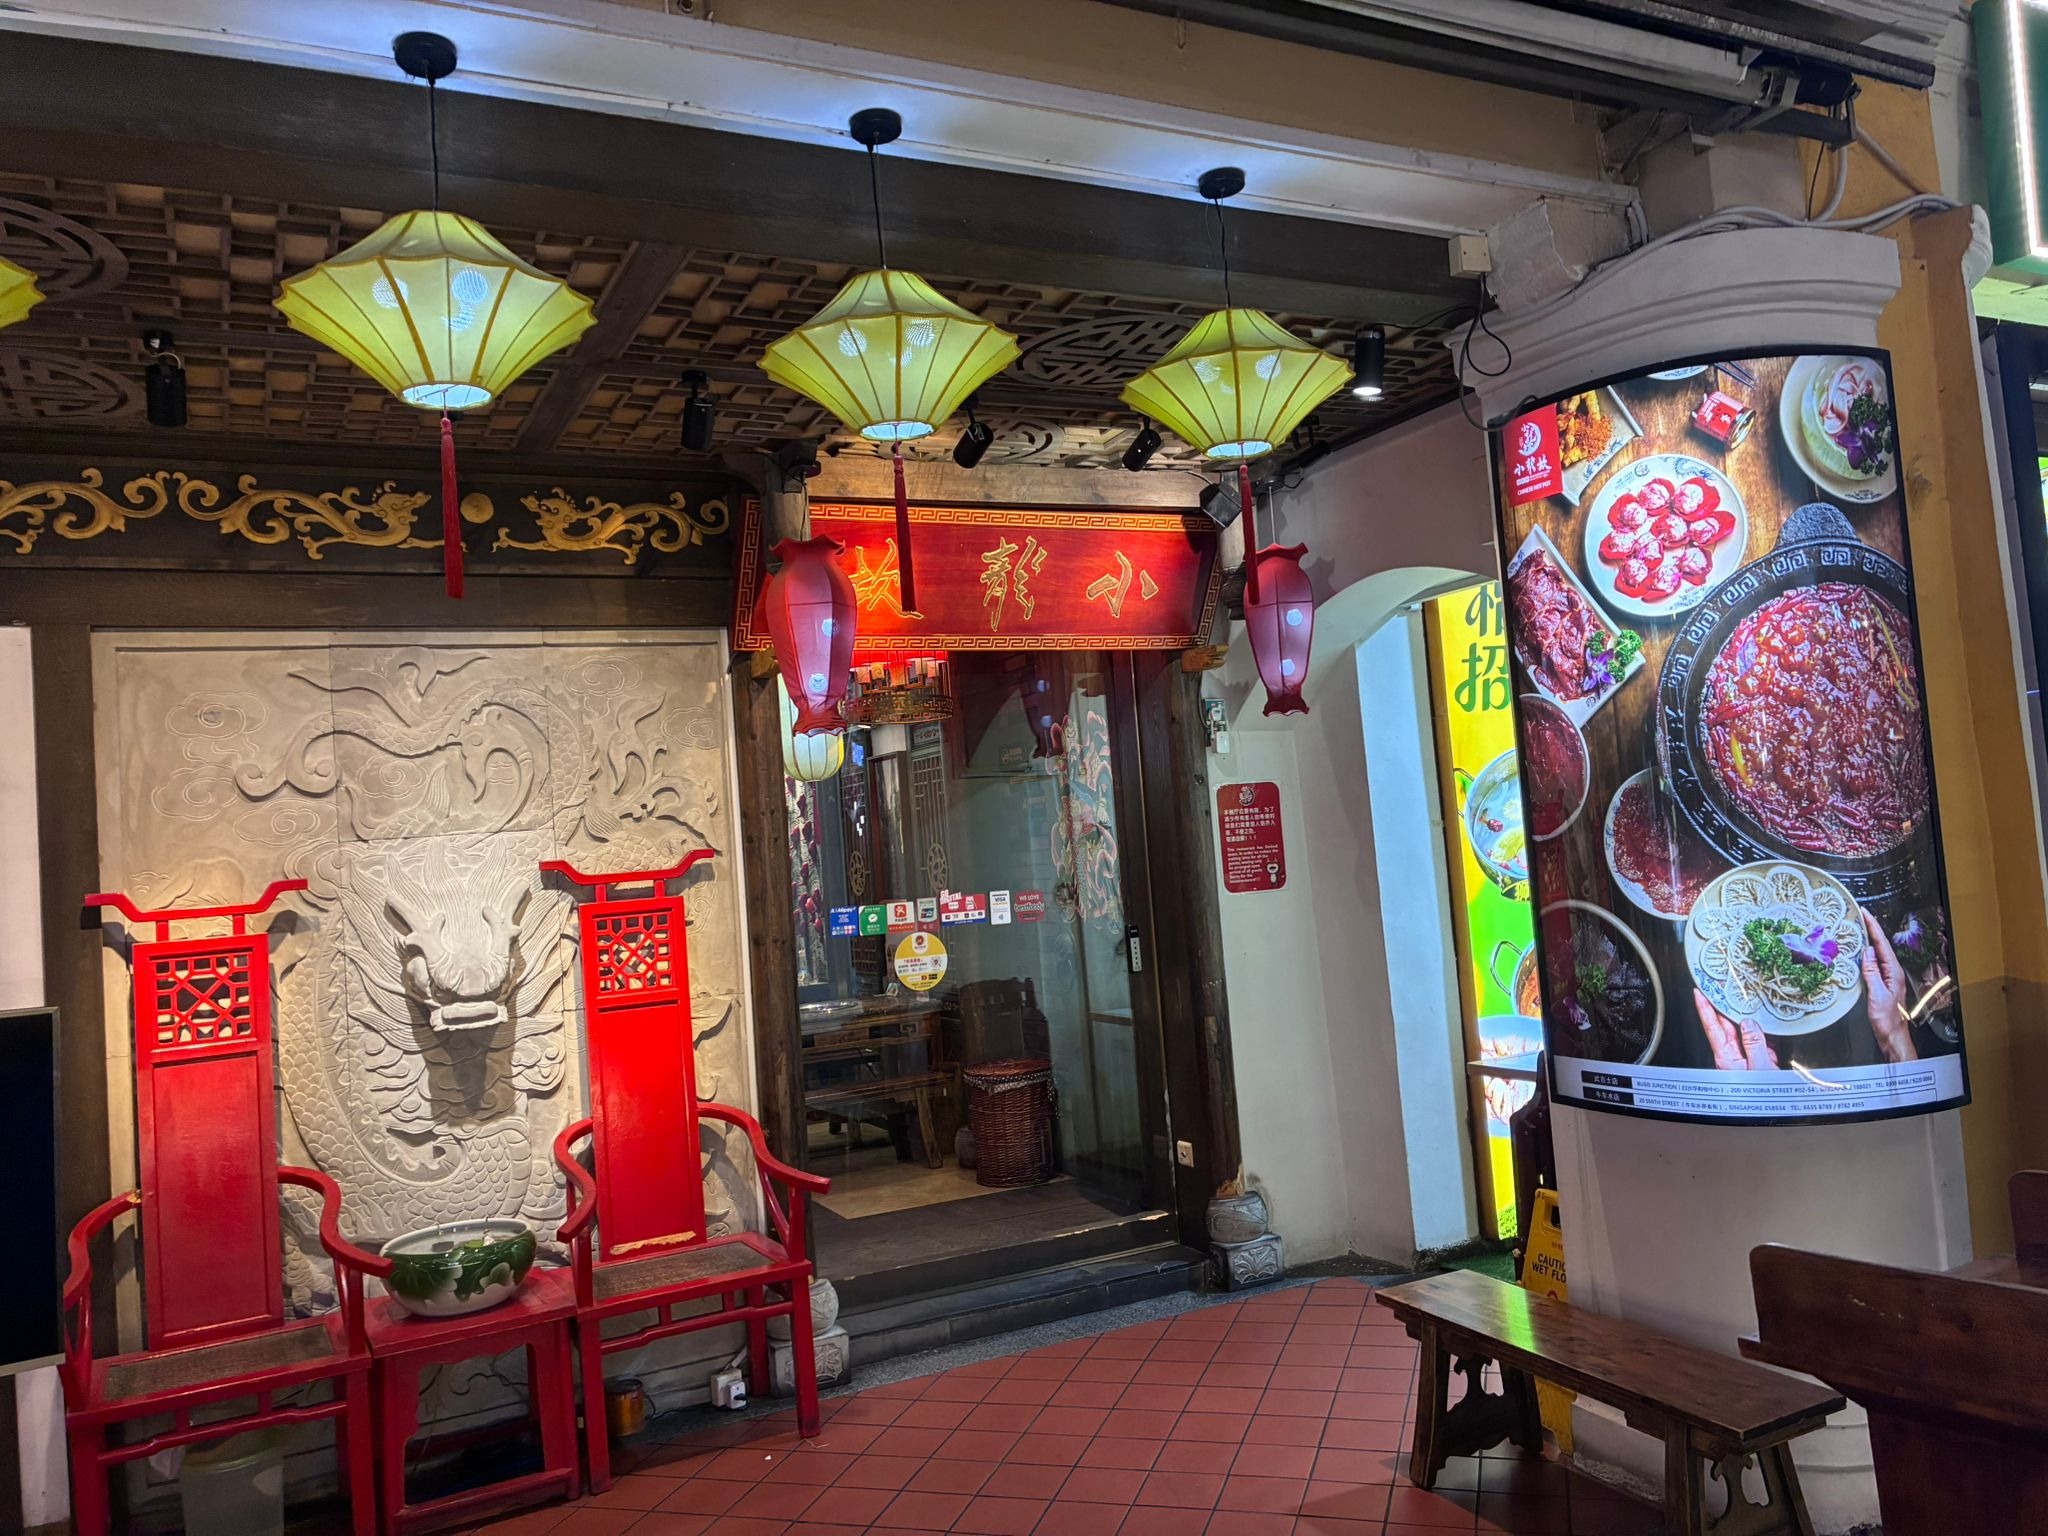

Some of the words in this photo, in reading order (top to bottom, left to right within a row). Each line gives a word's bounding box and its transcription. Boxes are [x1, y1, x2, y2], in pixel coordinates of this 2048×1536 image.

[1517, 485, 1534, 496] CHINESE
[1533, 482, 1543, 491] HOT
[1542, 480, 1552, 488] POT
[1652, 1082, 1678, 1091] JUNCTION
[1743, 1086, 1771, 1094] VICTORIA
[1772, 1086, 1793, 1094] STREET
[1532, 1261, 1549, 1275] WET
